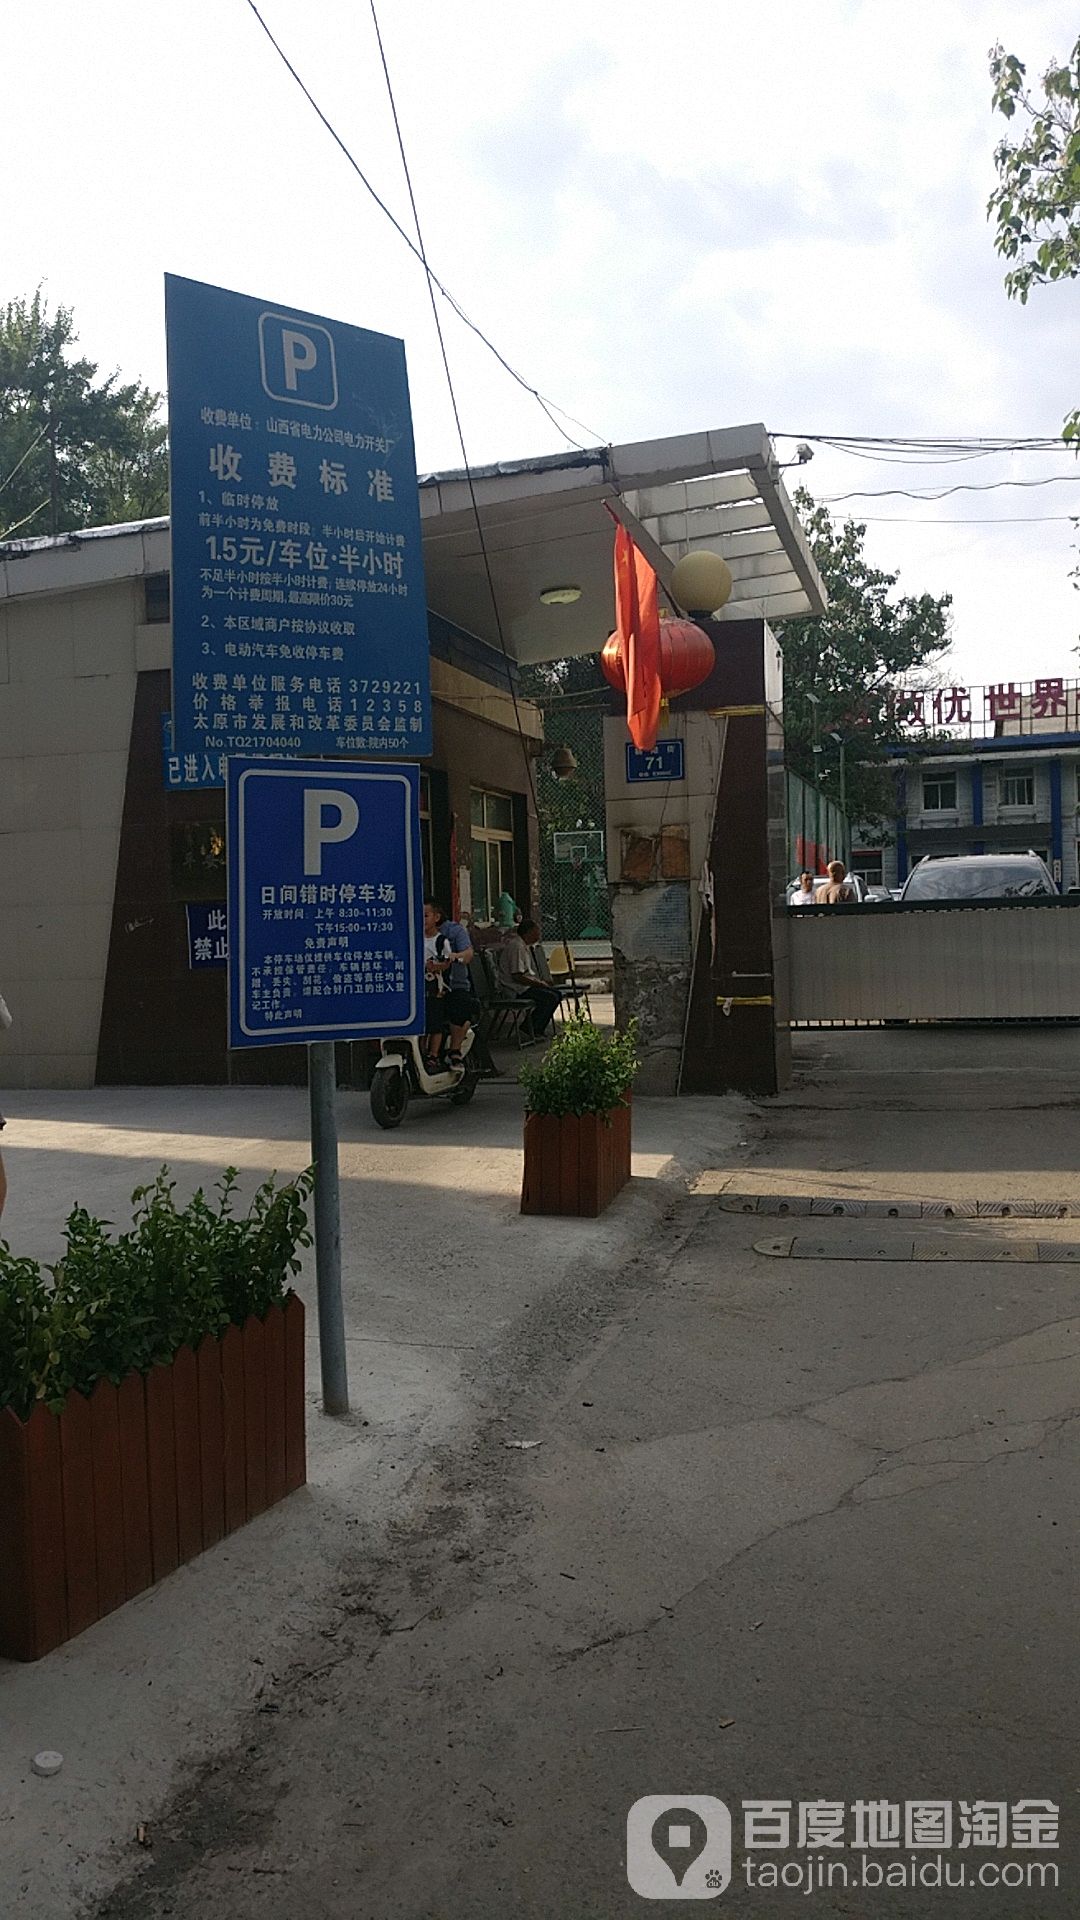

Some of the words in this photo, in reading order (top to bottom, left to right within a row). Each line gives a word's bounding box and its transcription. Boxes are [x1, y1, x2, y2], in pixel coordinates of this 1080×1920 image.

[281, 328, 318, 391] P
[208, 443, 395, 502] 收费标准
[193, 713, 423, 733] 太原市发展和改革委员会监制
[645, 756, 663, 770] 71
[303, 788, 360, 876] P
[261, 884, 397, 905] 日间错时停车场
[207, 909, 227, 932] 此
[193, 936, 228, 961] 禁止
